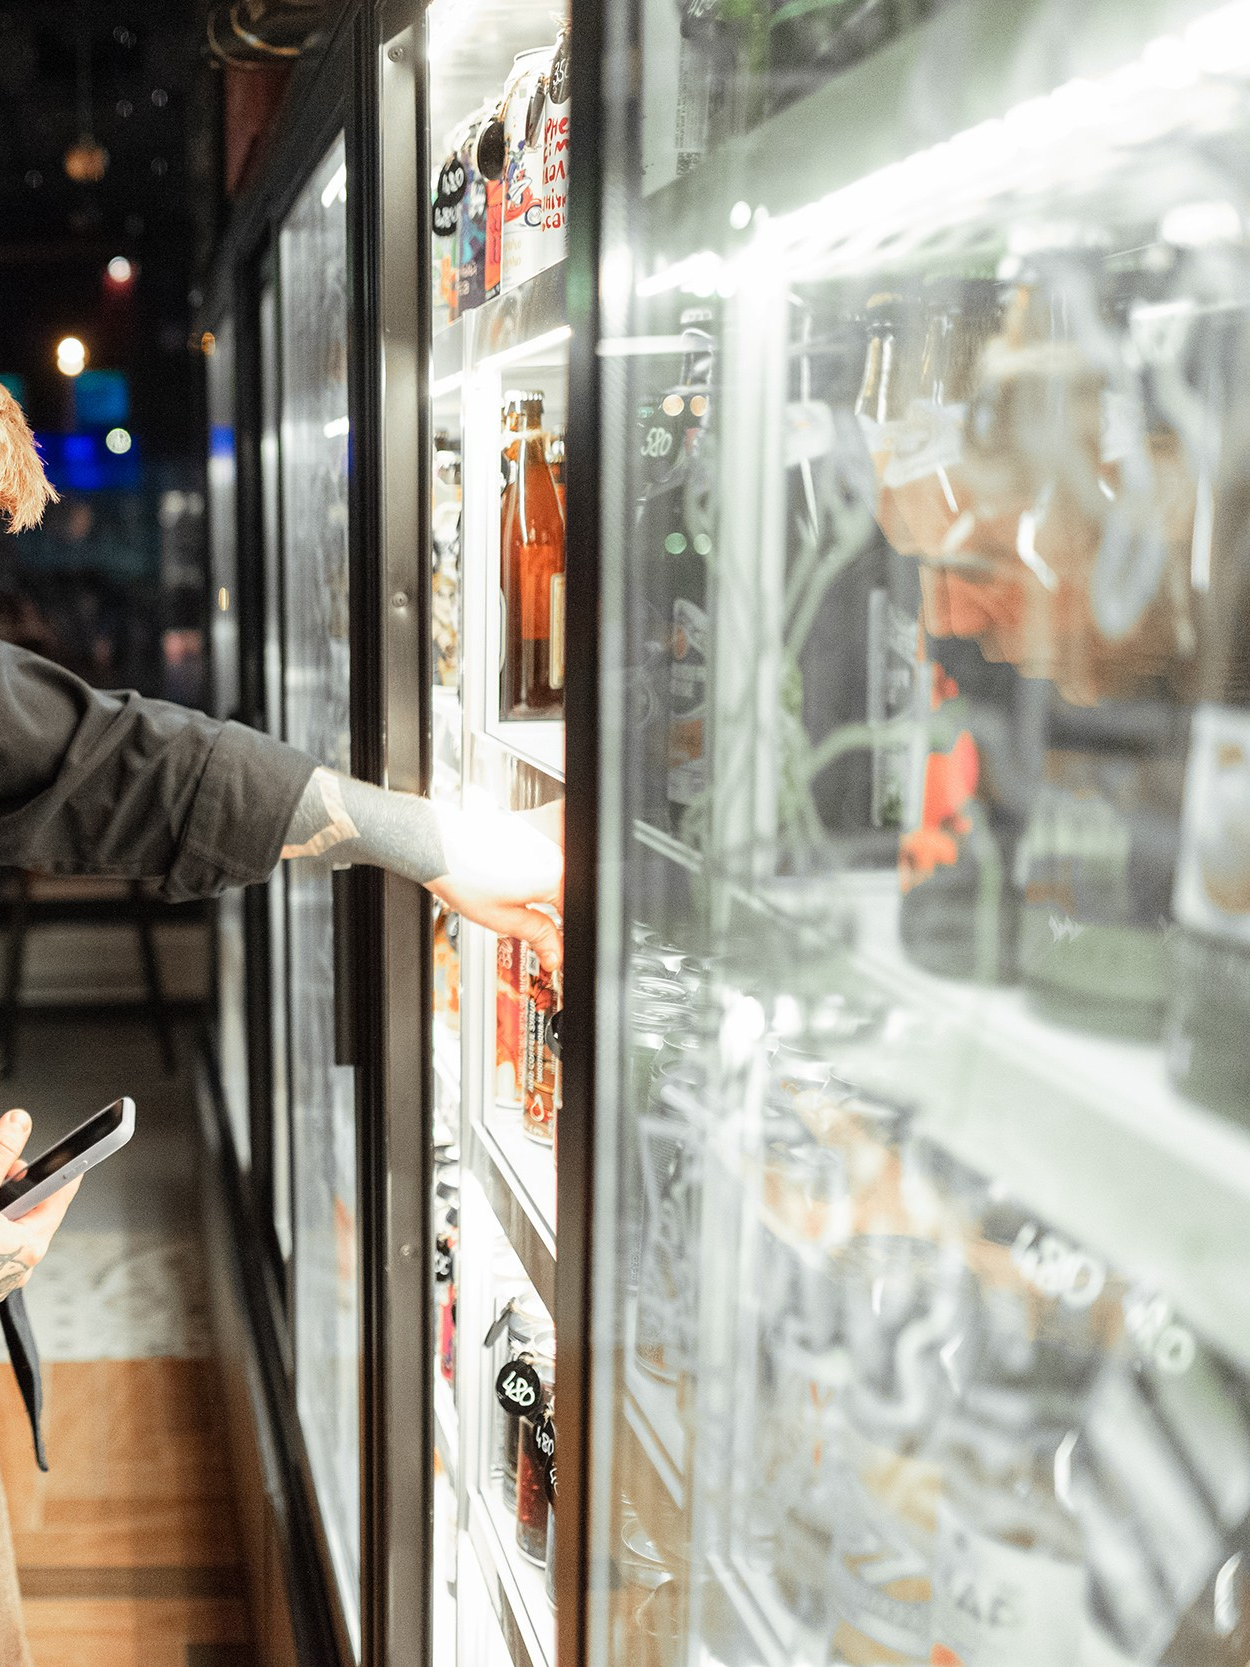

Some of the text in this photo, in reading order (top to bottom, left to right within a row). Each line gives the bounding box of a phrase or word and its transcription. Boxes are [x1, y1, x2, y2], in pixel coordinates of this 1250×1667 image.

[640, 426, 673, 457] 580
[502, 1370, 536, 1407] 480
[535, 1426, 554, 1456] 480
